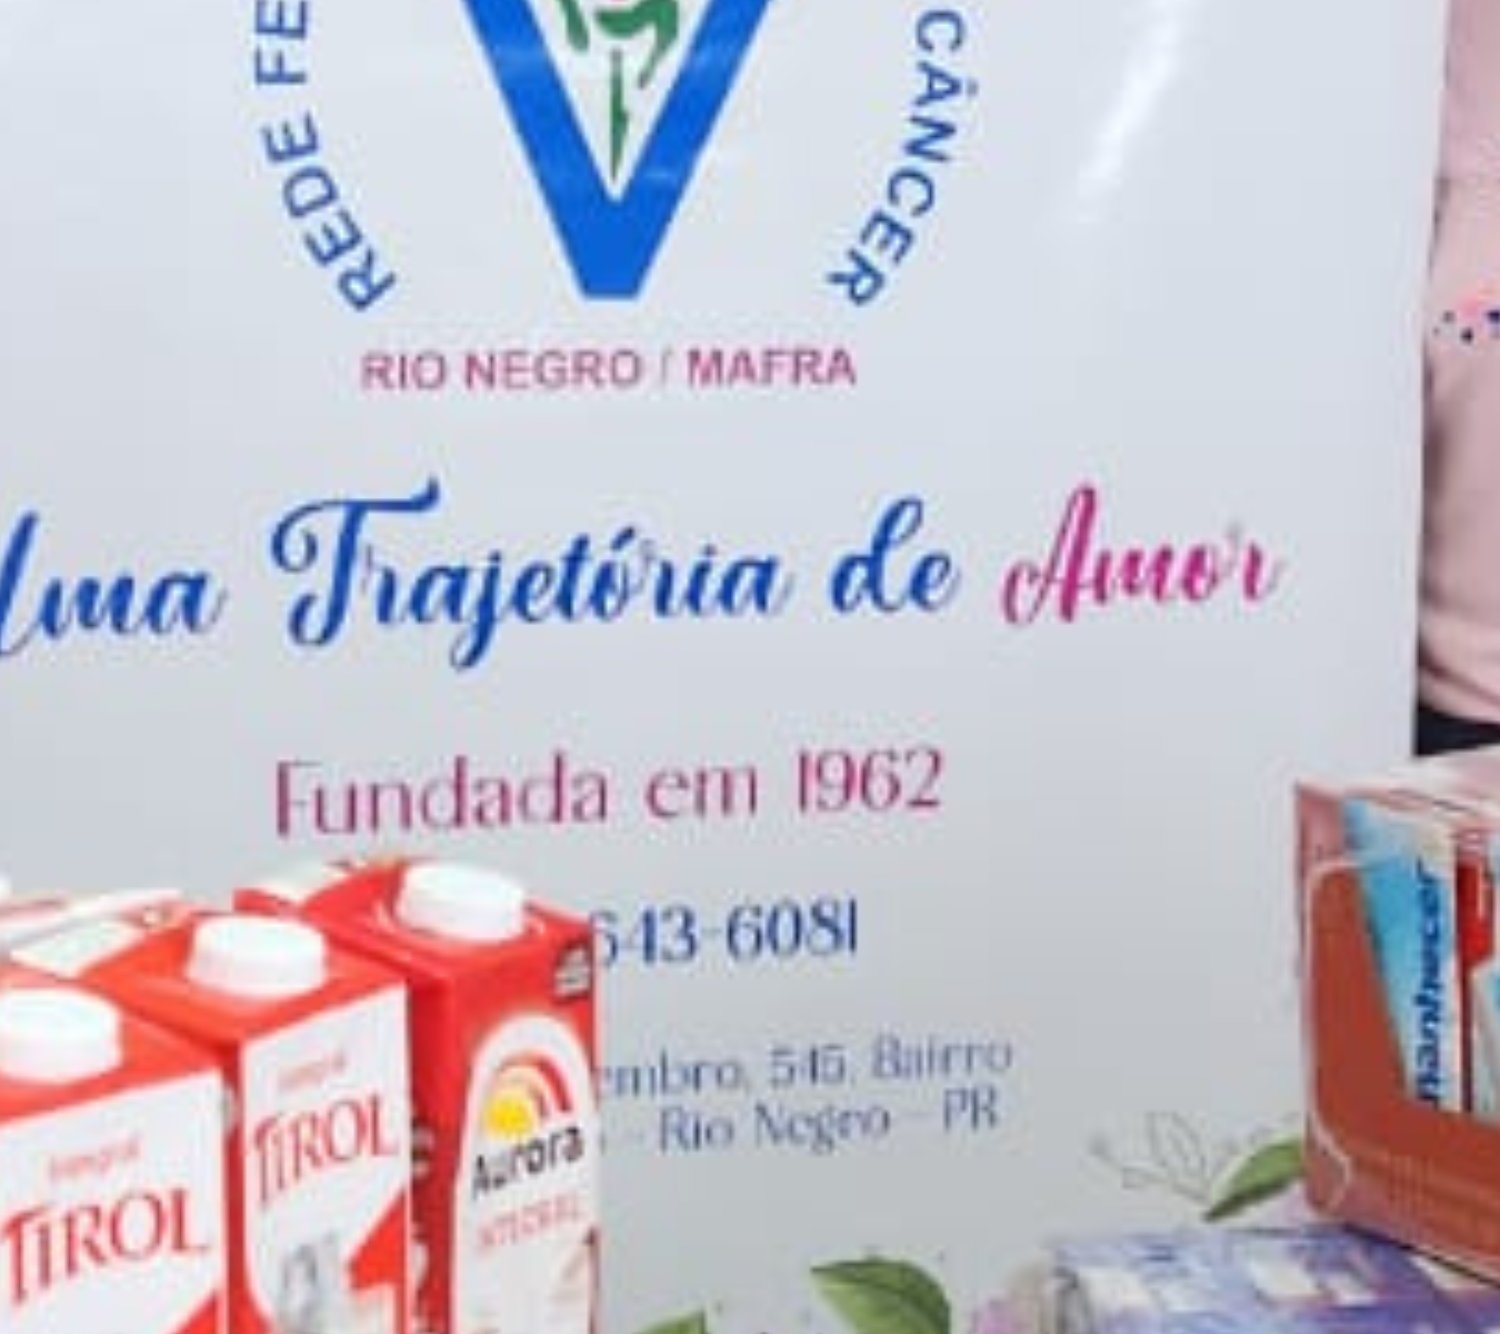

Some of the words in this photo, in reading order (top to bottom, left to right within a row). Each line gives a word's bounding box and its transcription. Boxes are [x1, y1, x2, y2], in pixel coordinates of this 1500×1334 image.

[263, 113, 396, 312] REDE
[826, 8, 978, 307] CÂNCER
[362, 349, 447, 391] RIO
[465, 348, 644, 389] NEGRO
[688, 346, 857, 386] MAFRA
[271, 476, 792, 671] Trajetória
[830, 497, 962, 615] de
[1000, 483, 1284, 627] Amor
[275, 752, 611, 838] Fundada
[645, 762, 758, 820] em
[797, 747, 944, 814] 1962
[873, 1033, 1013, 1078] Bairro
[254, 1094, 397, 1209] TIROL
[660, 1111, 733, 1154] Rio
[755, 1102, 891, 1155] Negro
[944, 1087, 998, 1131] PR
[2, 1187, 211, 1305] TIROL
